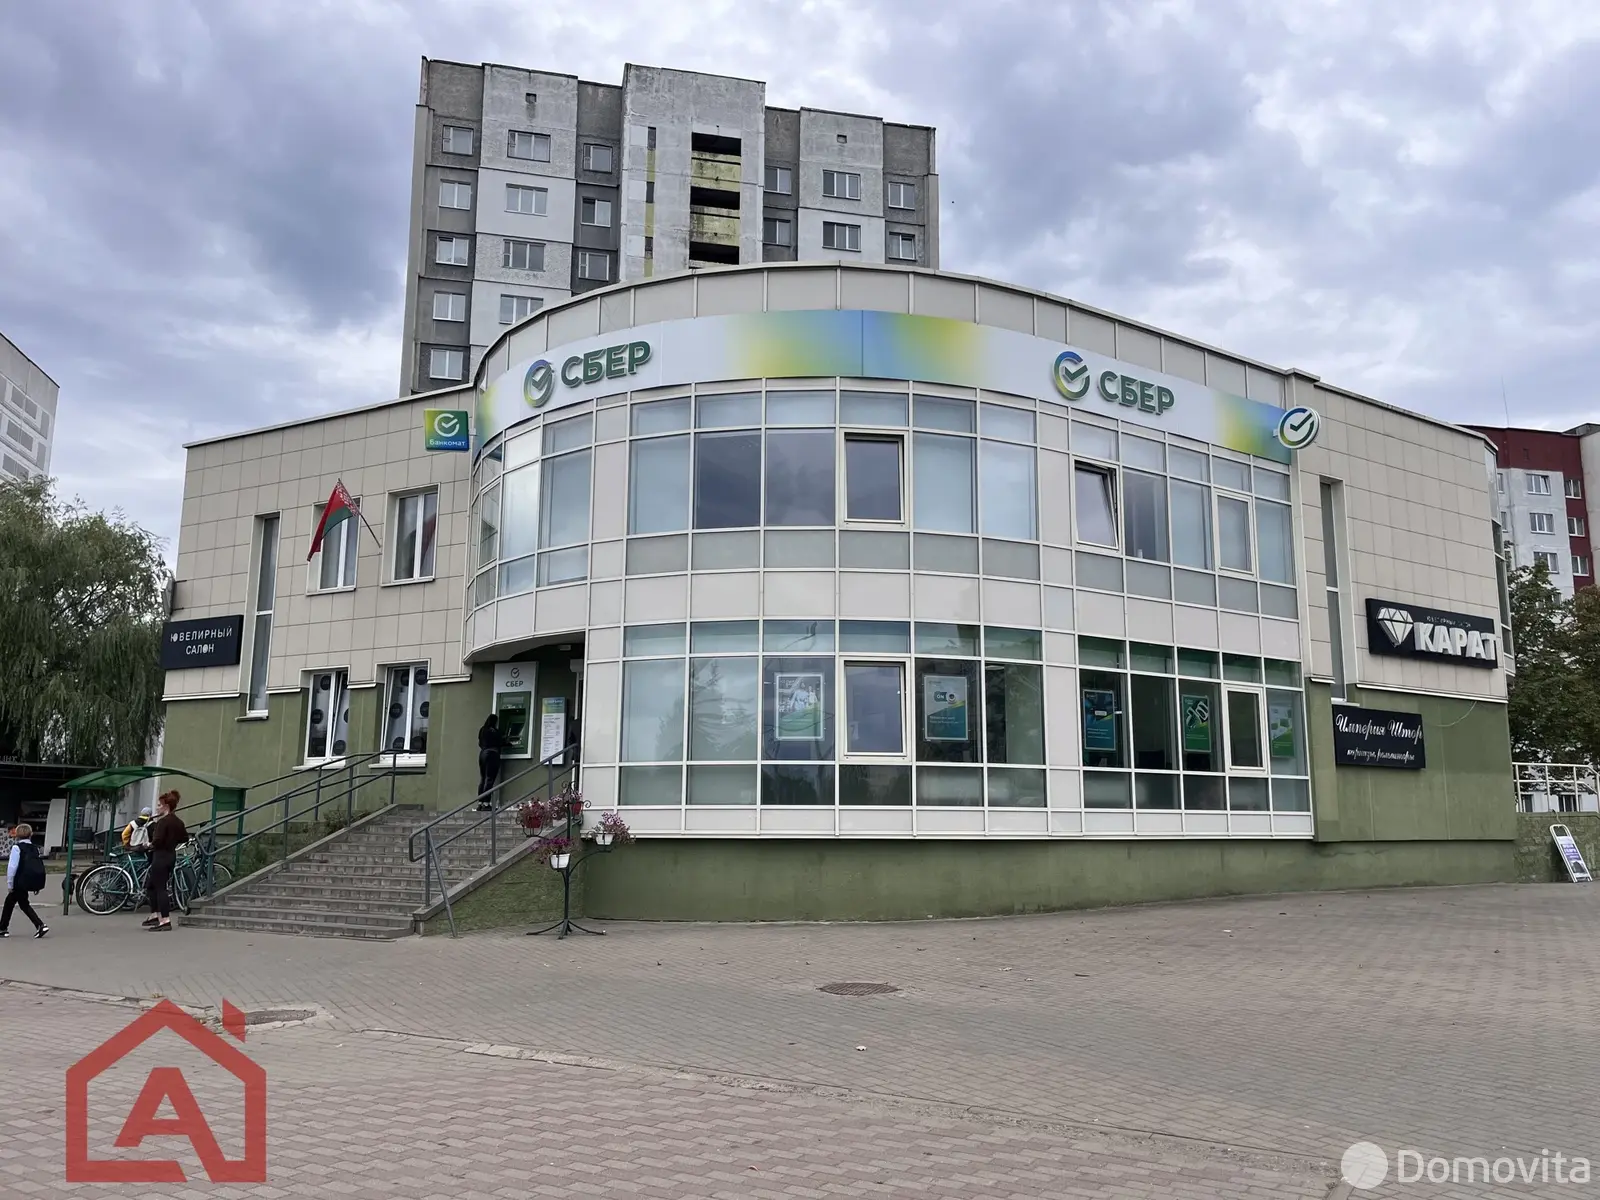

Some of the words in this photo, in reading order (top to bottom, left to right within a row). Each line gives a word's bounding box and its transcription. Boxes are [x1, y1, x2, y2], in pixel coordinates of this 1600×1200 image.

[561, 341, 651, 388] СБЕР
[1099, 370, 1175, 415] СБЕР
[170, 626, 232, 642] ЮВЕЛИРНЫЙ
[185, 643, 215, 655] САЛОН
[1413, 621, 1497, 661] КАРАТ
[505, 680, 523, 688] СБЕР
[1335, 713, 1386, 741] Империя
[1387, 720, 1424, 745] Штор
